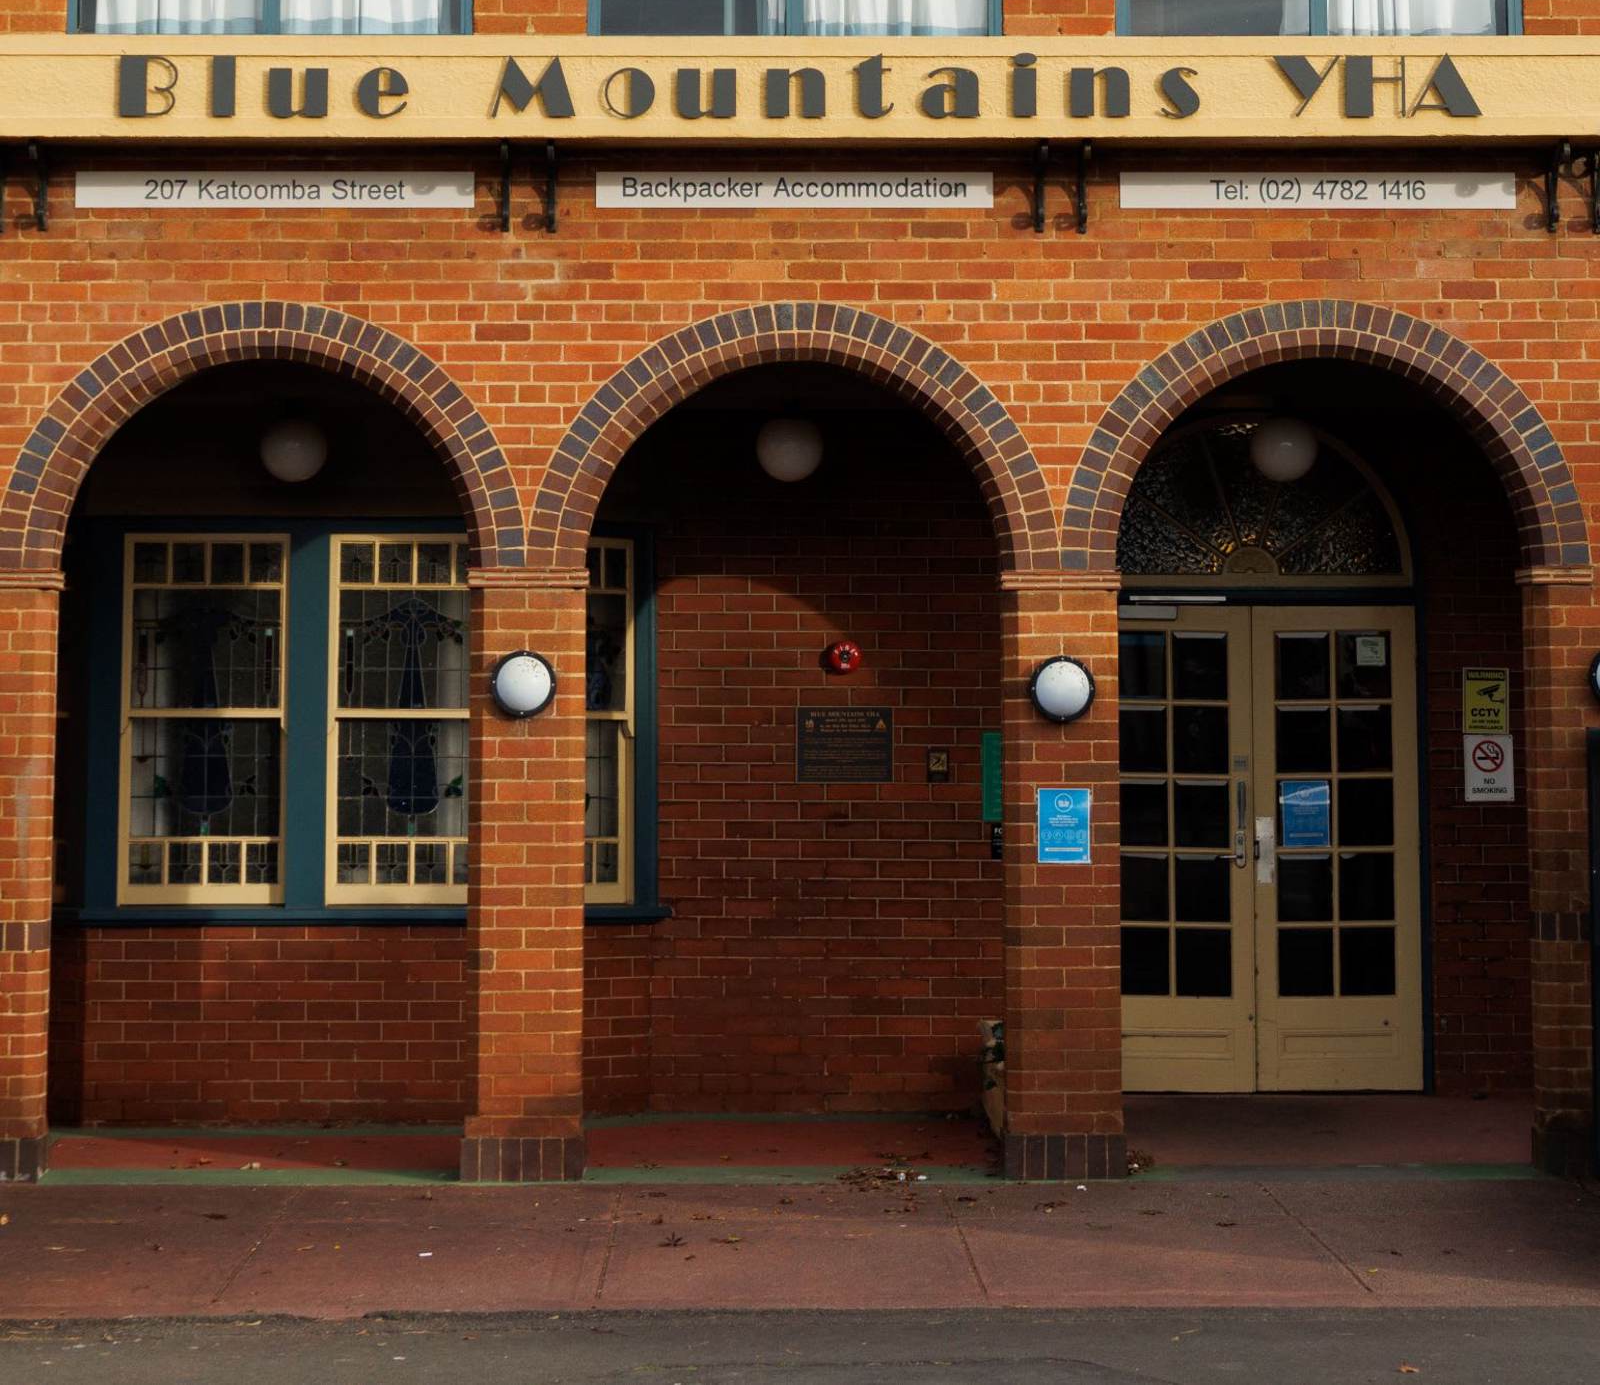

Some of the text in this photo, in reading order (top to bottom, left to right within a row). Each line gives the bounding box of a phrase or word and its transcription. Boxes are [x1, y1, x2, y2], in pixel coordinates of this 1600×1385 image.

[118, 52, 1482, 118] Blue Mountains YHA
[144, 178, 406, 200] 207 Katoomba Street
[621, 177, 967, 203] Backpacker Accommodation
[1210, 177, 1426, 204] Tel: (02) 4782 1416
[1467, 671, 1505, 680] WARNING
[1471, 708, 1500, 717] CCTV
